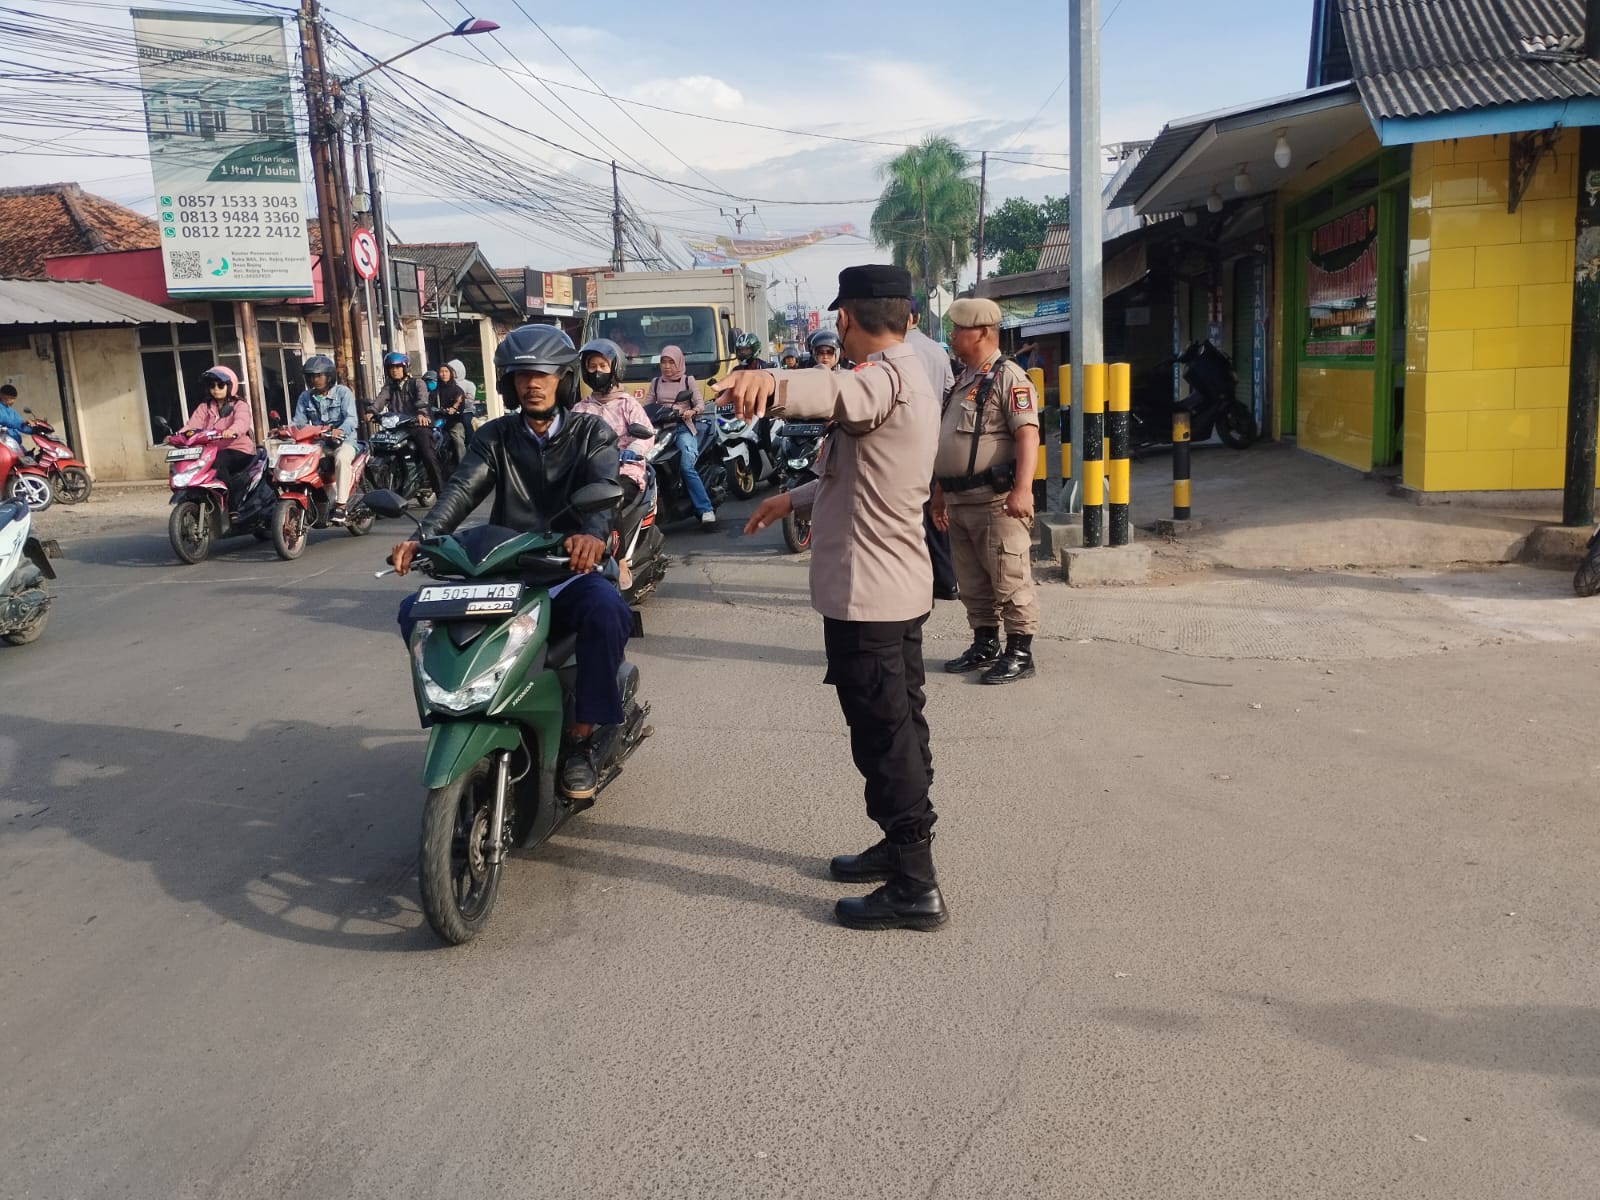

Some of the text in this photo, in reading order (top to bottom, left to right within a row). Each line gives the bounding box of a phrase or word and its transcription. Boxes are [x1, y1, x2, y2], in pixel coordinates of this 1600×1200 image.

[220, 52, 274, 65] SEJAHTERA
[273, 156, 294, 165] ringan
[221, 165, 228, 175] 1
[256, 165, 261, 177] /
[265, 165, 296, 176] bulan
[178, 195, 298, 208] 0857 1533 3043
[180, 211, 300, 223] 0813 9484 3360
[182, 226, 302, 238] 0812 1222 2412
[422, 589, 432, 600] A
[441, 587, 478, 600] 5051
[512, 681, 534, 707] HONDA
